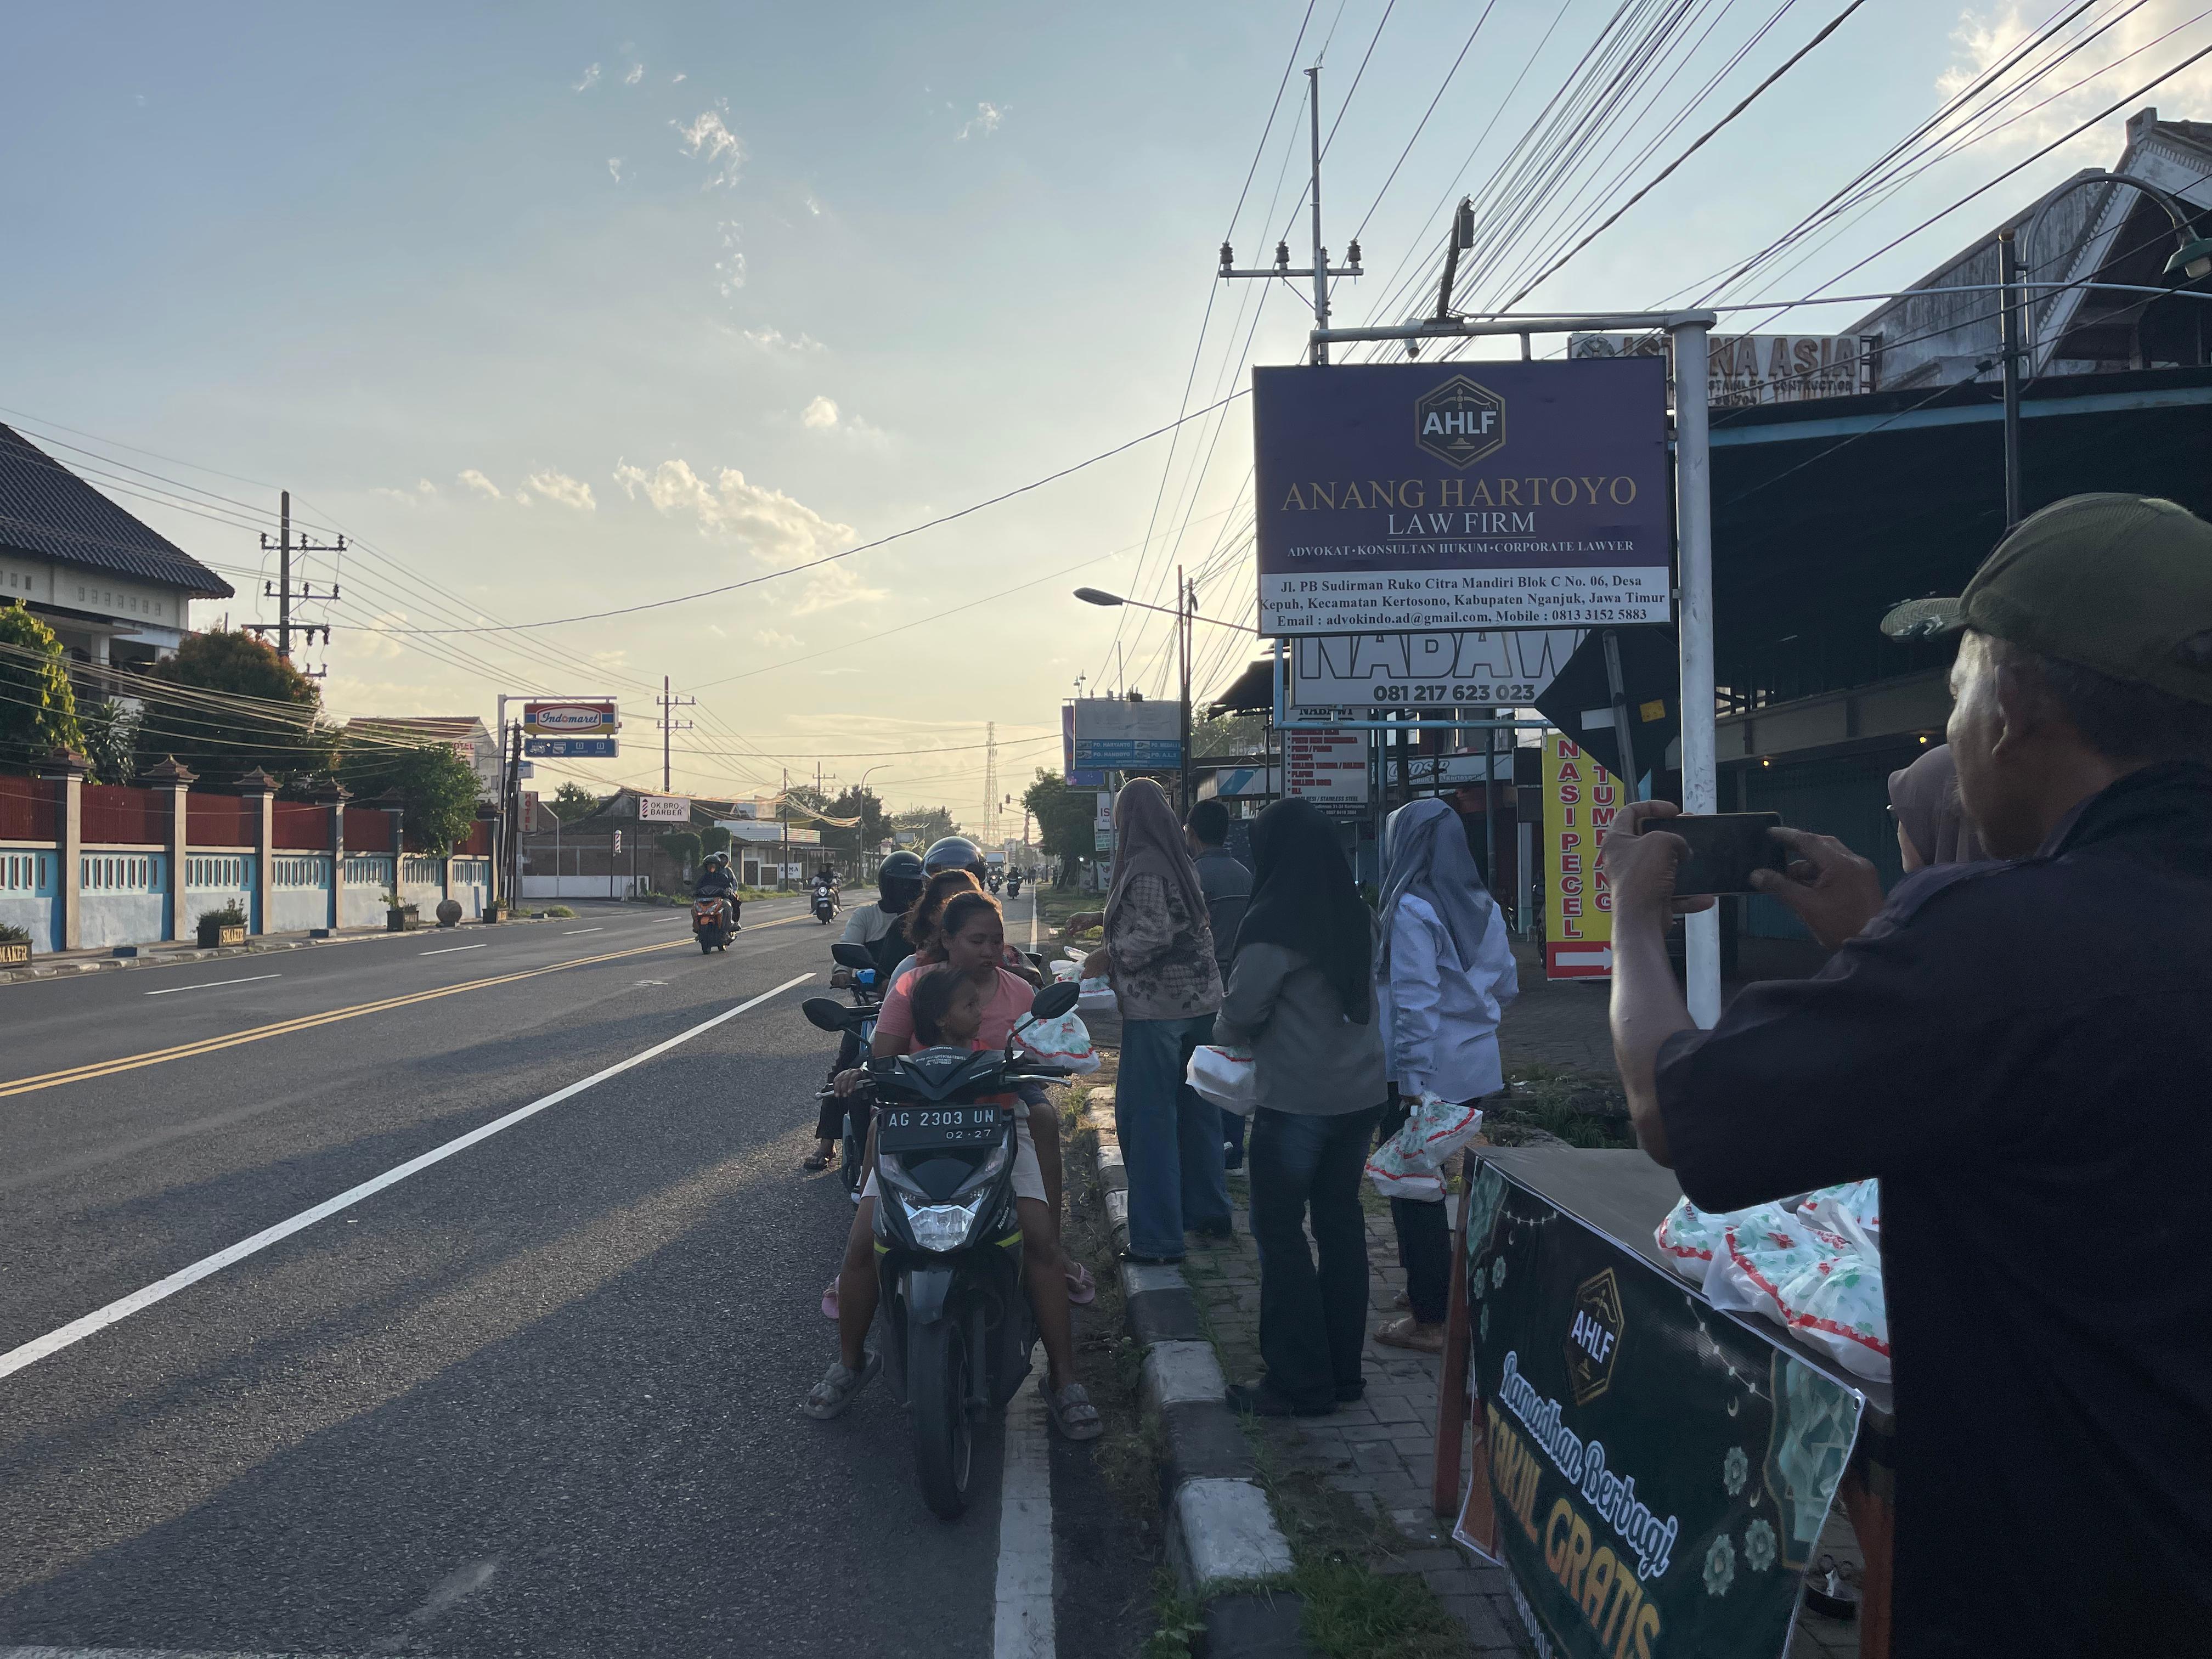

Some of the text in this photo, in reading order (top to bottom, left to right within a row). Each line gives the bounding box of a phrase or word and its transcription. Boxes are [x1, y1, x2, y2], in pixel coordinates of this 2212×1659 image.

[1624, 337, 1856, 376] ISTNA ASIA
[1422, 410, 1497, 435] AHLF
[1280, 476, 1637, 511] ANANG HARTOYO
[1387, 511, 1536, 535] LAW FIRM
[1578, 540, 1634, 551] LAWYER
[1281, 575, 1641, 592] Jl. PB Sudirman Ruko Citra Mandiri Blok C No. 06, Desa
[1261, 592, 1665, 612] Kepuh, Kecamatan Kertosono, Kabupaten Nganjuk, Jawa Timur
[1277, 615, 1313, 627] Email
[1326, 612, 1492, 627] advokindo.ad@gmail.com,
[1496, 610, 1539, 622] Mobile
[1551, 609, 1581, 620] 0813
[1585, 609, 1613, 620] 3152
[1618, 608, 1647, 620] 5883
[1373, 684, 1536, 702] 081 217 623 023
[540, 712, 599, 724] Indomaret
[1557, 738, 1583, 827] NASI
[1560, 832, 1583, 939] PECEL
[0, 946, 27, 962] MAKER
[889, 1109, 995, 1127] AG 2303 UN
[1571, 1310, 1615, 1364] AHLF
[1499, 1351, 1583, 1485] Ramadhan
[1581, 1440, 1678, 1581] Berbagi
[1545, 1498, 1661, 1659] GRATIS
